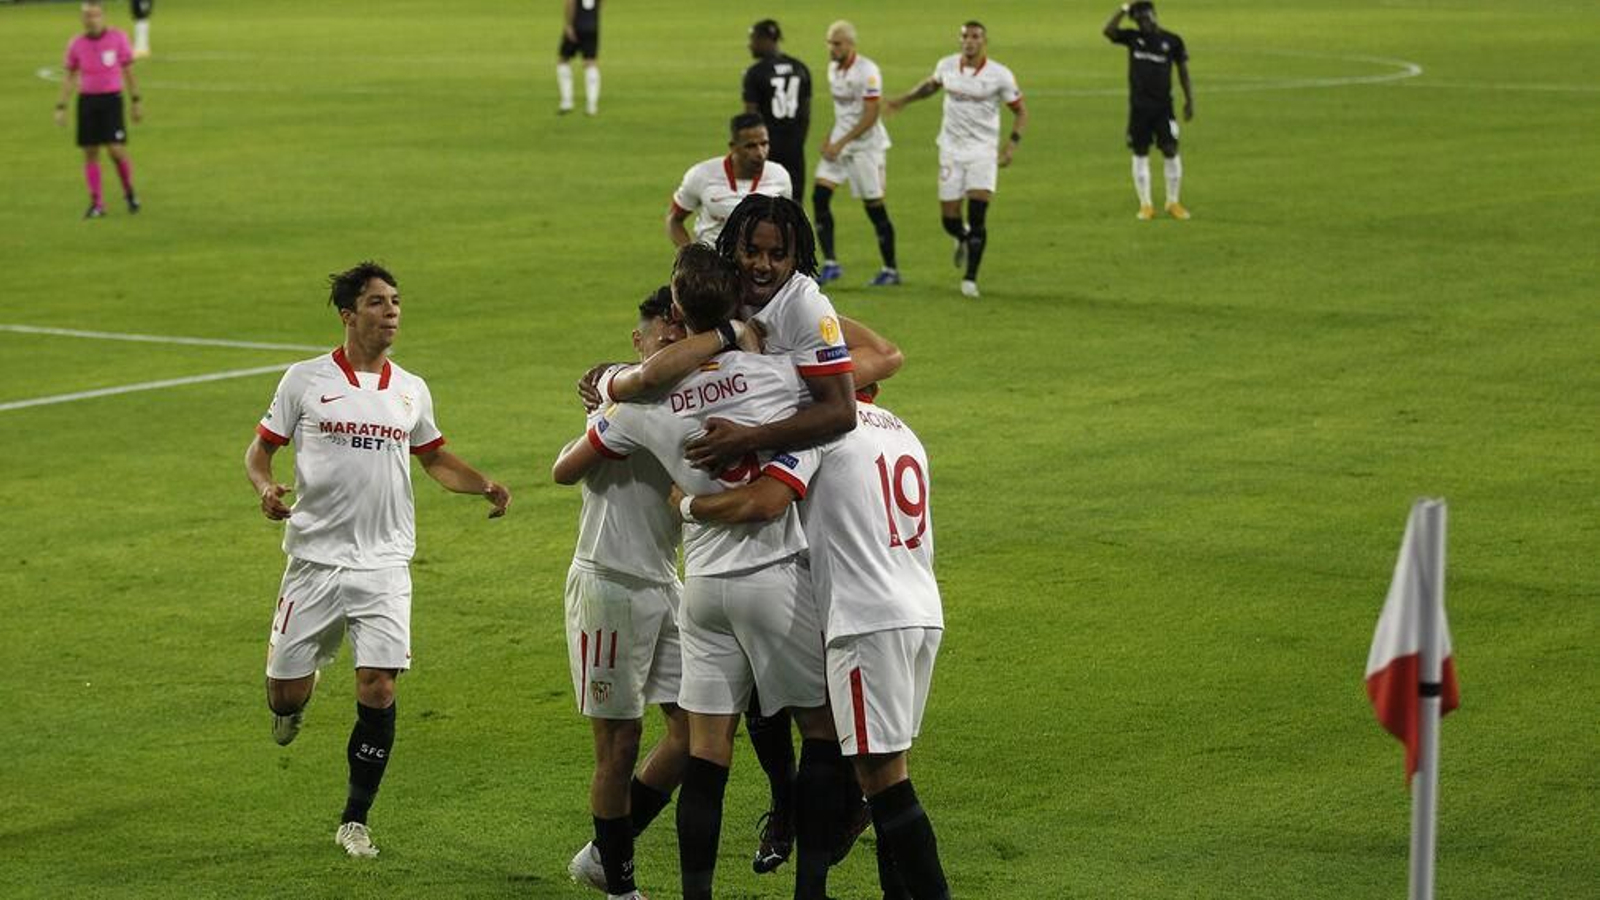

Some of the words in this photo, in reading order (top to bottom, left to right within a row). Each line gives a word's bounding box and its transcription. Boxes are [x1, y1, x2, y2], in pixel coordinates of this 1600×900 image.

[770, 76, 800, 119] 34
[669, 389, 696, 413] DE
[698, 373, 748, 409] JONG
[351, 436, 384, 450] BET
[875, 452, 926, 549] 19
[593, 629, 617, 669] 11
[360, 743, 385, 758] SFC
